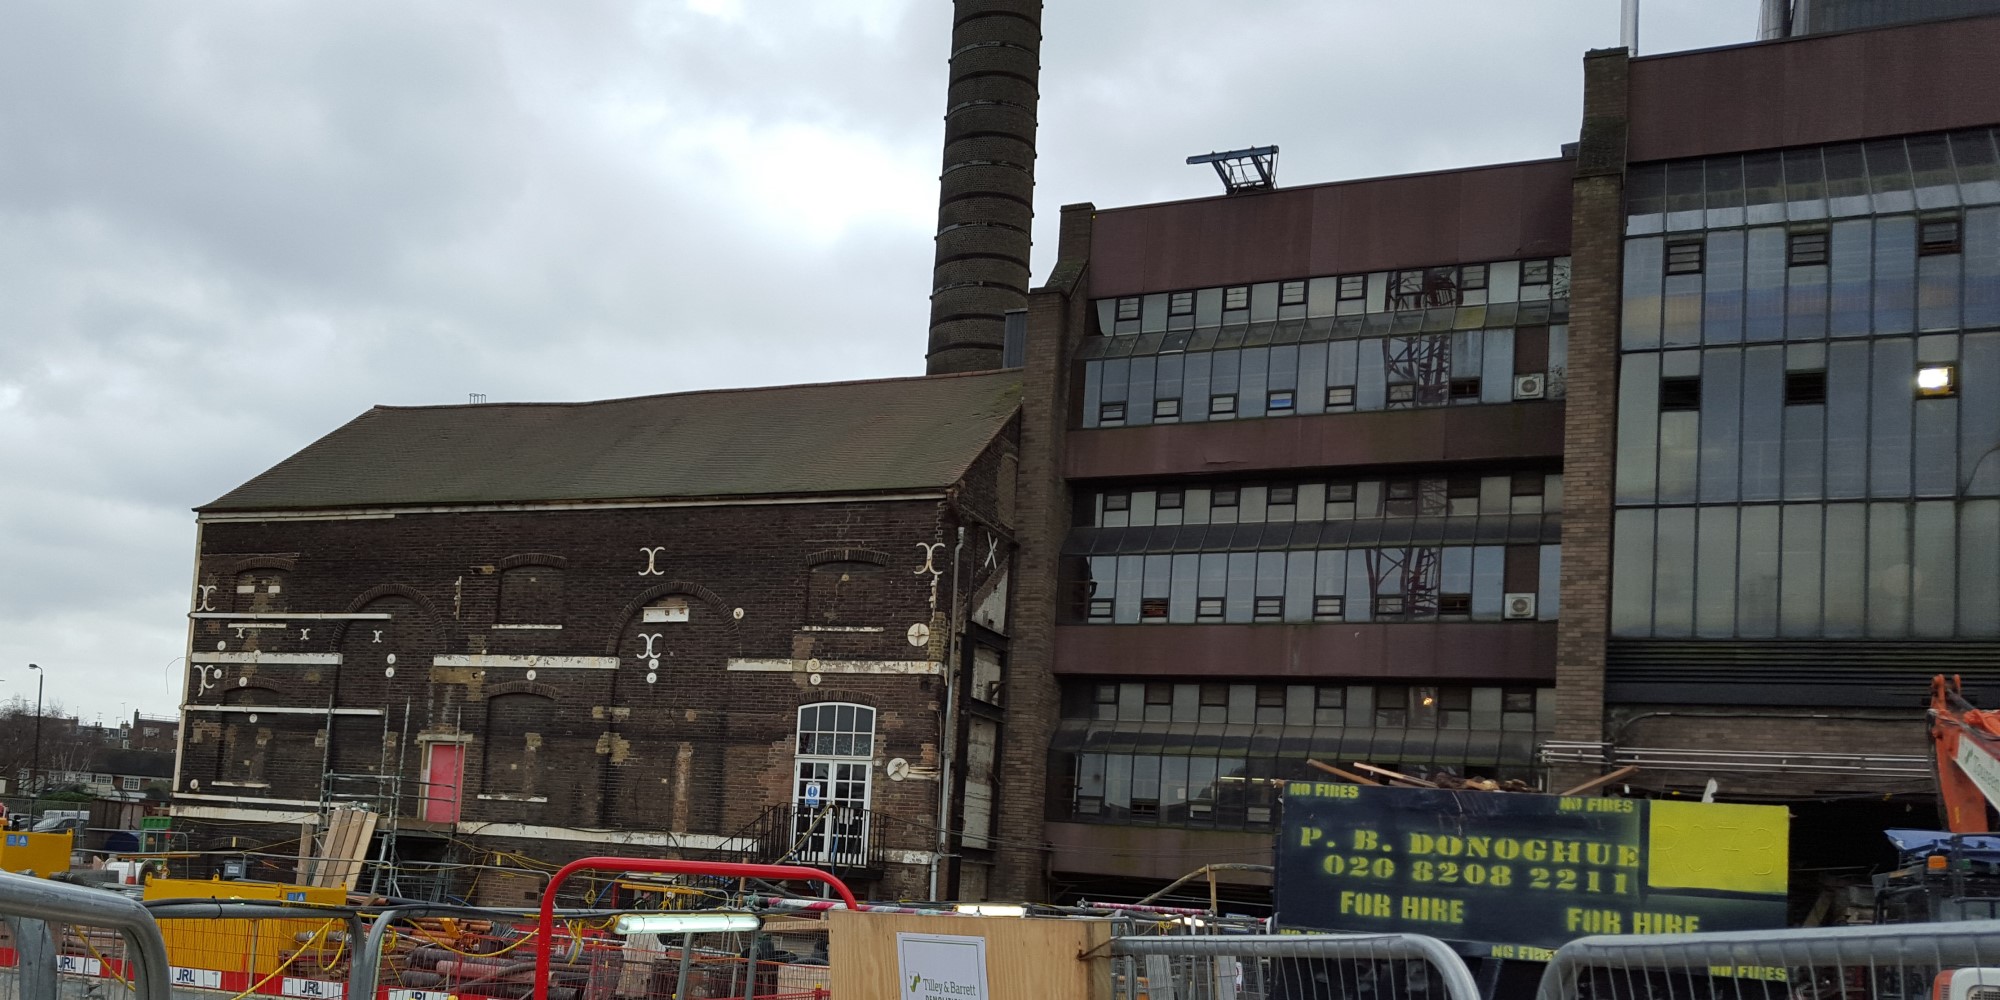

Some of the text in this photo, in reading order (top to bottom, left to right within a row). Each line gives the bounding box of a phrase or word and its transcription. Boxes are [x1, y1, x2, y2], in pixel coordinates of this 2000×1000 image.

[1290, 783, 1359, 799] NO FIRES
[1408, 832, 1640, 867] DONOGHUE
[1323, 854, 1628, 894] 020 8208 2211
[1340, 891, 1465, 924] FOR HIRE
[1566, 907, 1621, 934] FOR
[58, 956, 77, 970] JRL
[176, 968, 196, 982] JRL
[301, 980, 322, 995] JRL
[923, 978, 976, 996] Tilley & Barrett
